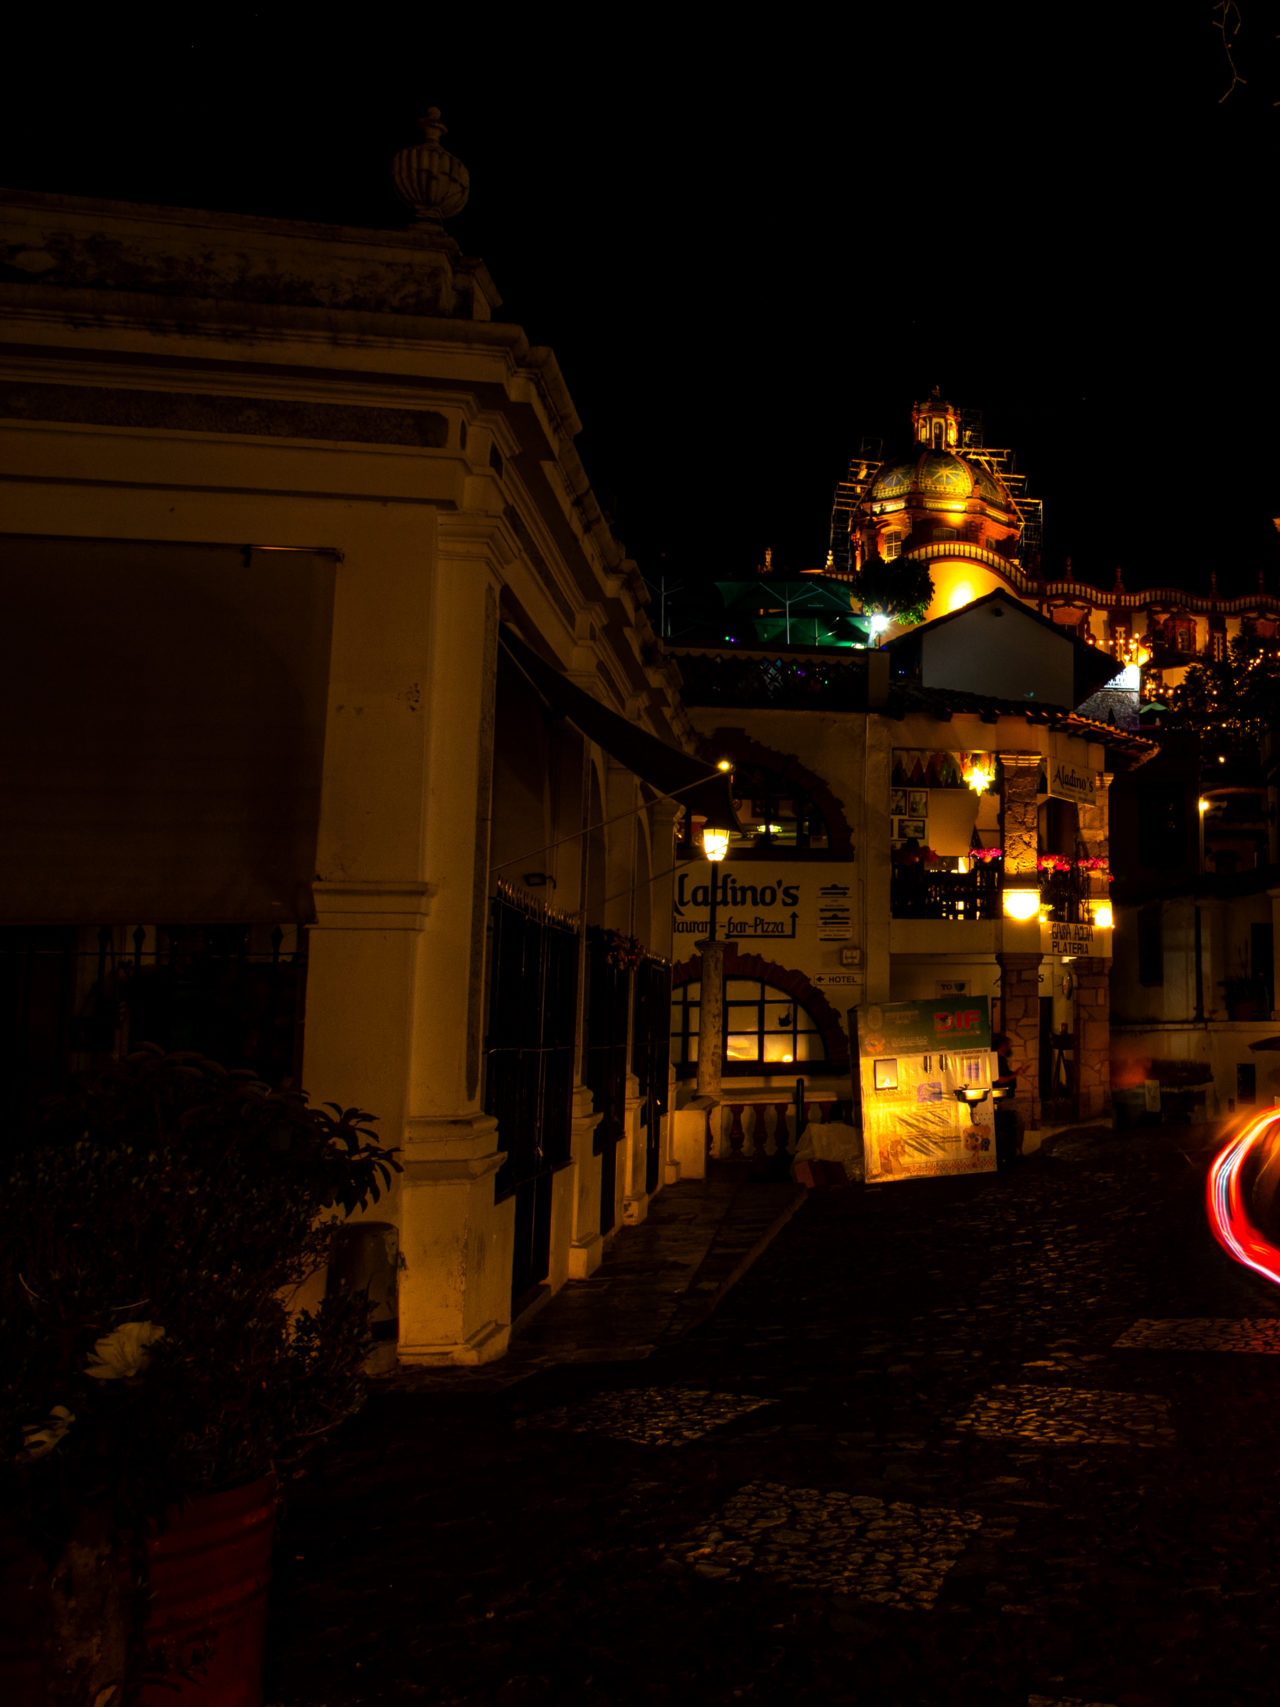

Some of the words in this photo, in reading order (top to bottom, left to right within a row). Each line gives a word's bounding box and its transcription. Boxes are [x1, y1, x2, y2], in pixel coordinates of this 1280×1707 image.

[1052, 765, 1094, 793] Aladino's
[674, 873, 801, 916] ladino's
[828, 975, 857, 984] HOTEL
[934, 1010, 981, 1032] DIF
